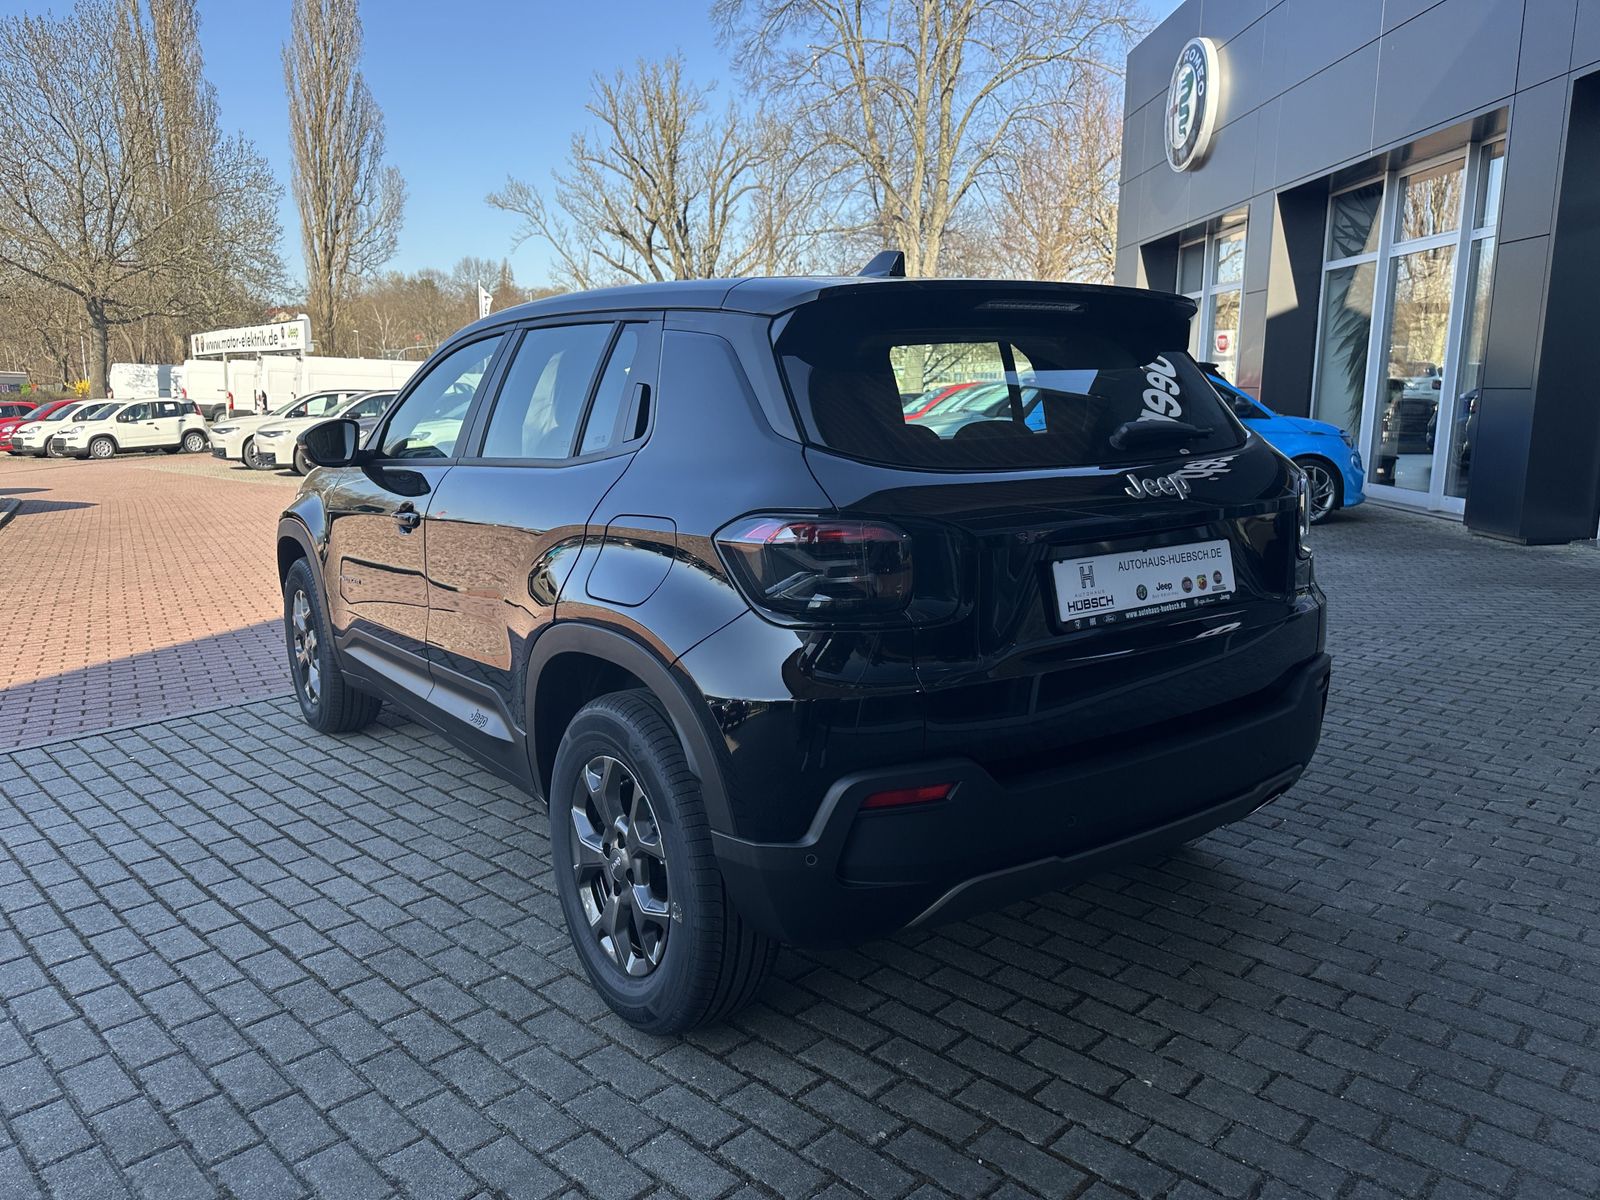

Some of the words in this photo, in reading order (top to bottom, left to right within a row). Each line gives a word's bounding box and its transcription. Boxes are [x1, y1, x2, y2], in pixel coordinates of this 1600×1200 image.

[1184, 49, 1204, 96] ROMEO
[205, 328, 279, 351] www.motor-elektrik.de
[1124, 473, 1192, 501] Jeep
[1118, 548, 1222, 572] AUTOHAUS-HUEBSCH.DE
[1155, 582, 1173, 592] Jeep
[1125, 601, 1187, 619] www.autohaus-huebsch.de
[469, 709, 488, 728] Jeep
